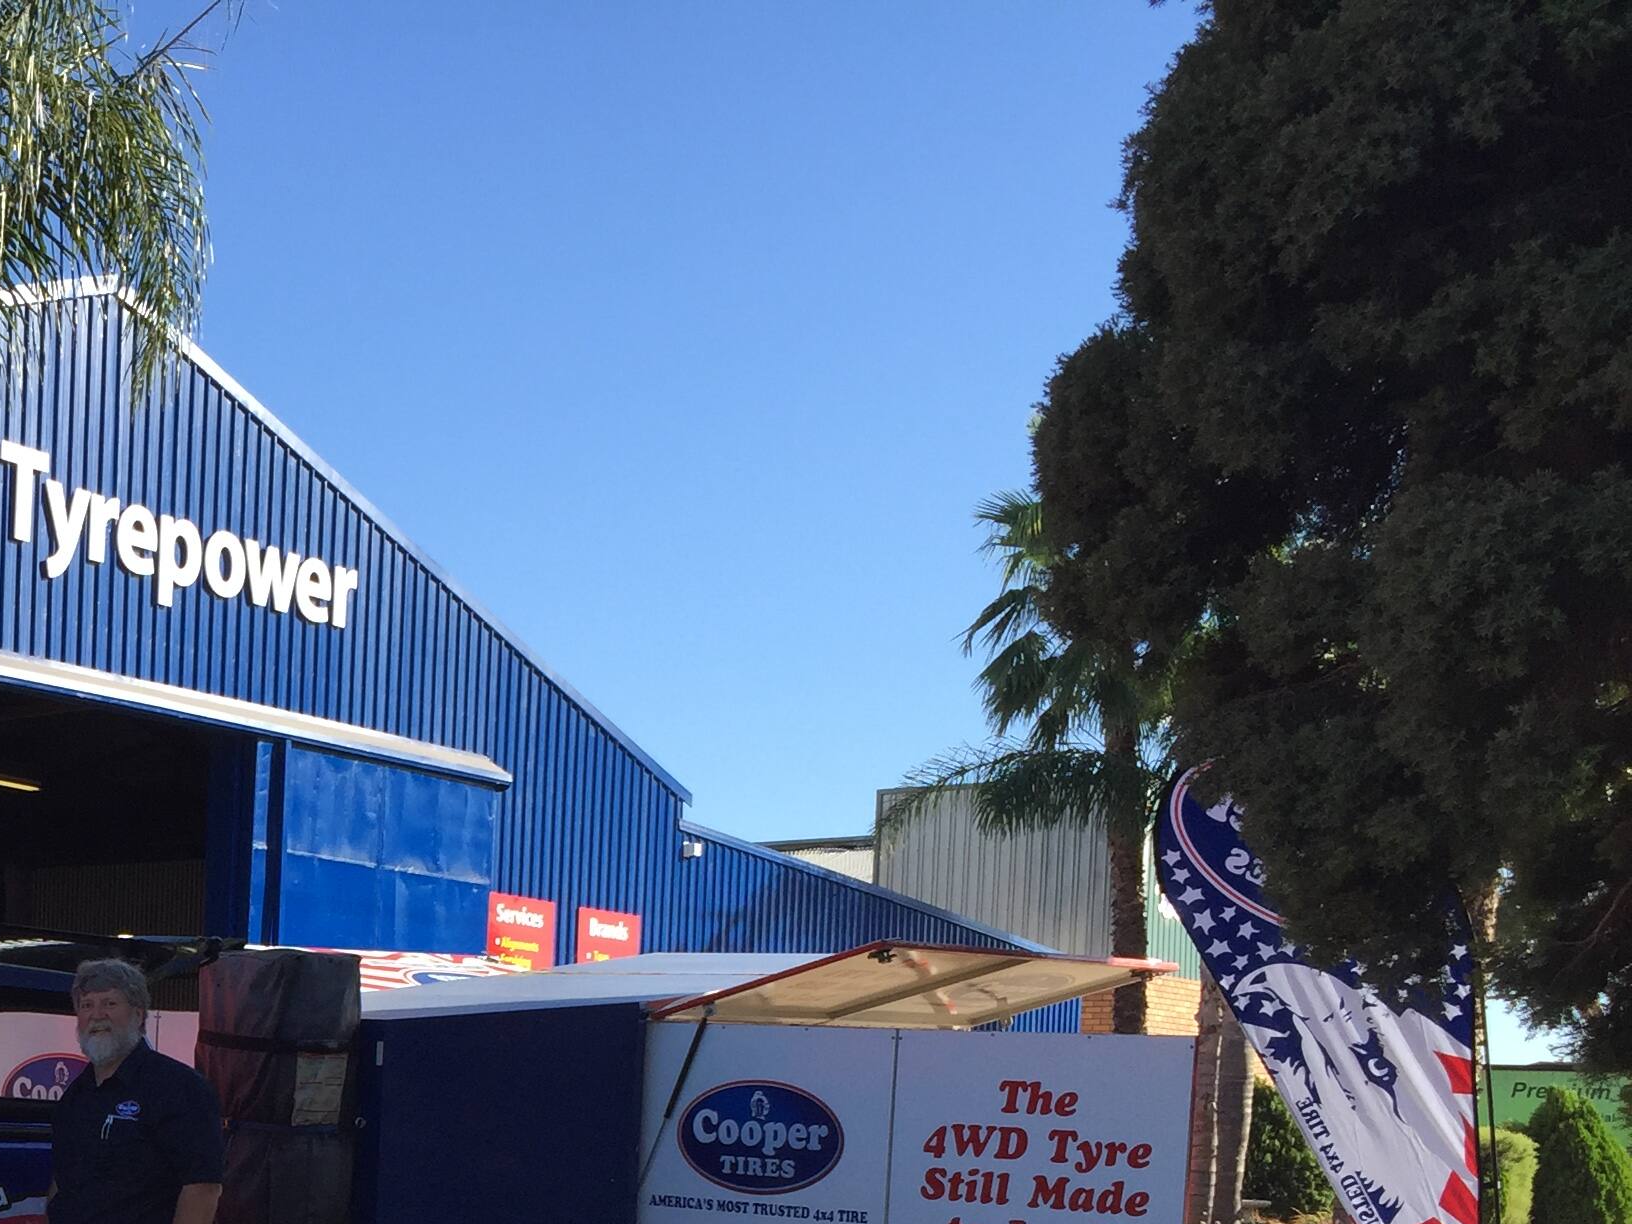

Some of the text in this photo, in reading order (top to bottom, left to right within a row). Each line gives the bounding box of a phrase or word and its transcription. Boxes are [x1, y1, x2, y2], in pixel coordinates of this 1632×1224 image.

[495, 903, 544, 929] Services
[588, 917, 630, 942] Brands
[999, 1080, 1078, 1117] The
[1511, 1082, 1611, 1100] Preium
[692, 1108, 828, 1157] Cooper
[923, 1123, 1153, 1174] 4WD Tyre
[720, 1155, 796, 1180] TIRES
[920, 1168, 1150, 1217] Still Made
[649, 1194, 868, 1224] AMERICA'S MOST TRUSTED 4x4 TIRE
